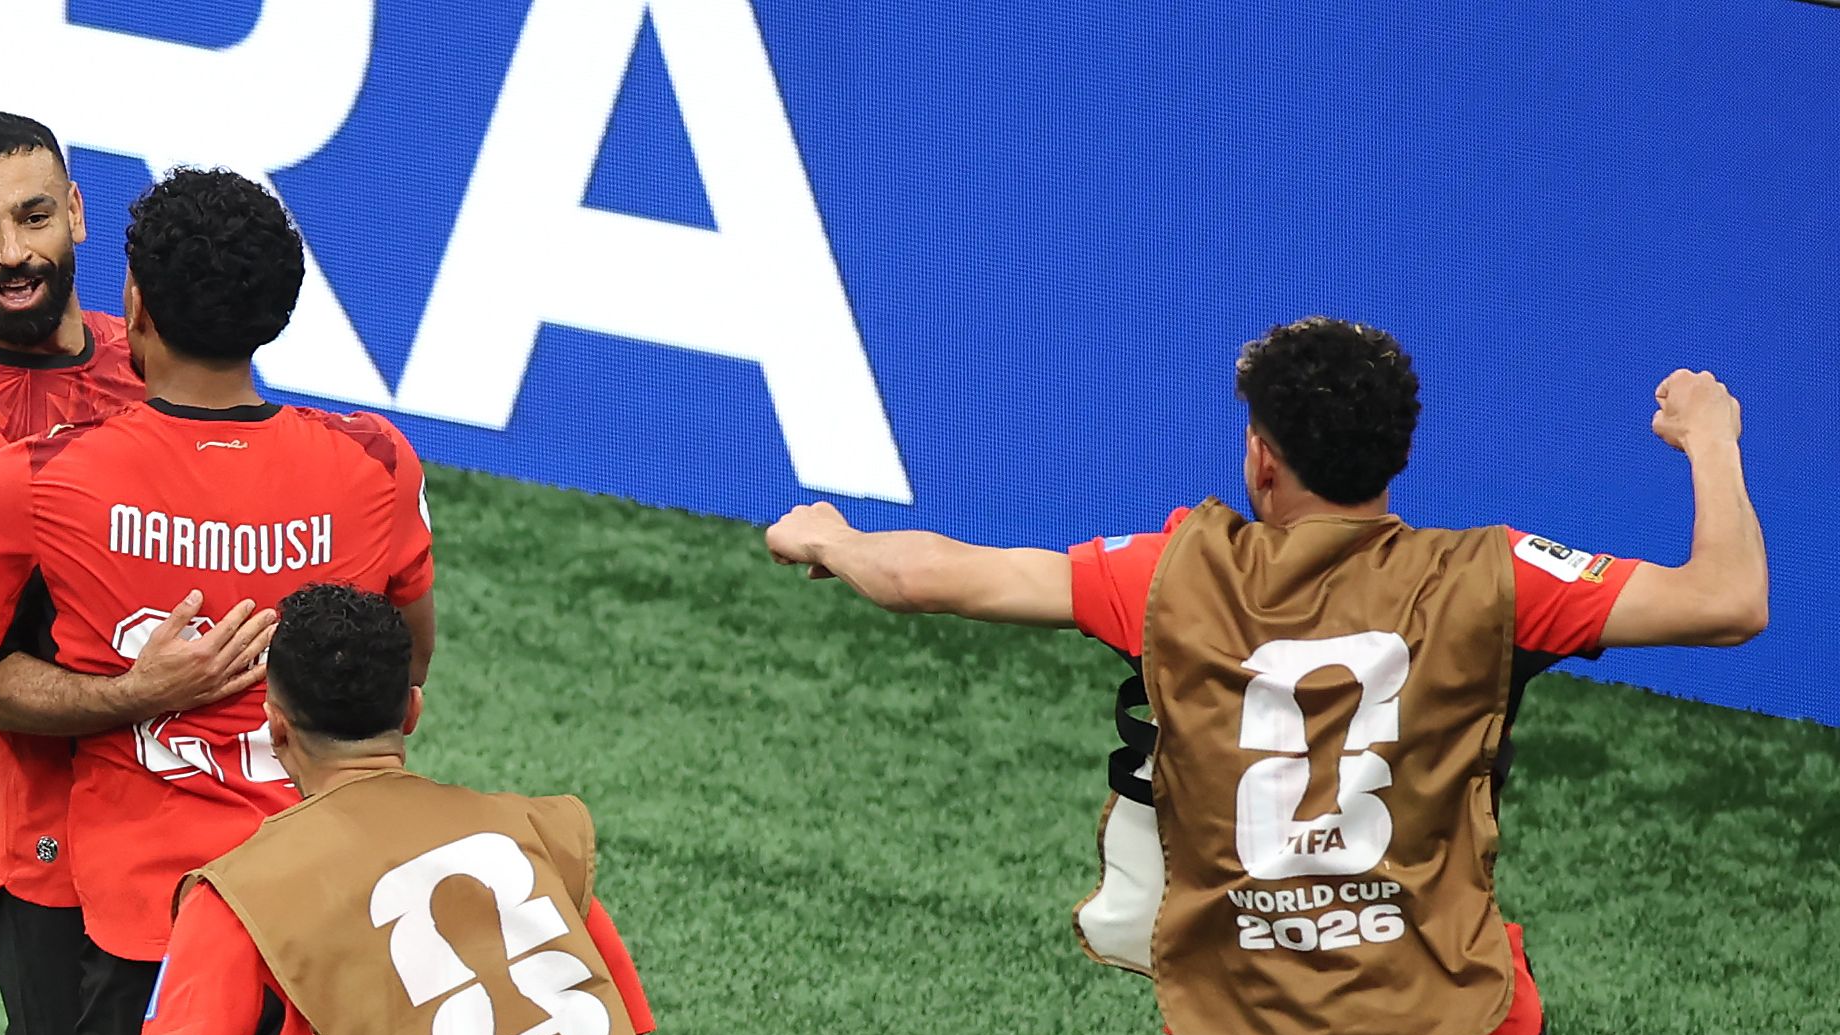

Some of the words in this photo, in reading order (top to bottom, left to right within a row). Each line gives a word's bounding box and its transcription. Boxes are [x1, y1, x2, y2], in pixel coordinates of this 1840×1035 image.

[109, 503, 332, 575] MARMOUSH
[1227, 884, 1335, 913] WORLD
[1339, 881, 1401, 903] CUP
[1236, 903, 1406, 952] 2026
